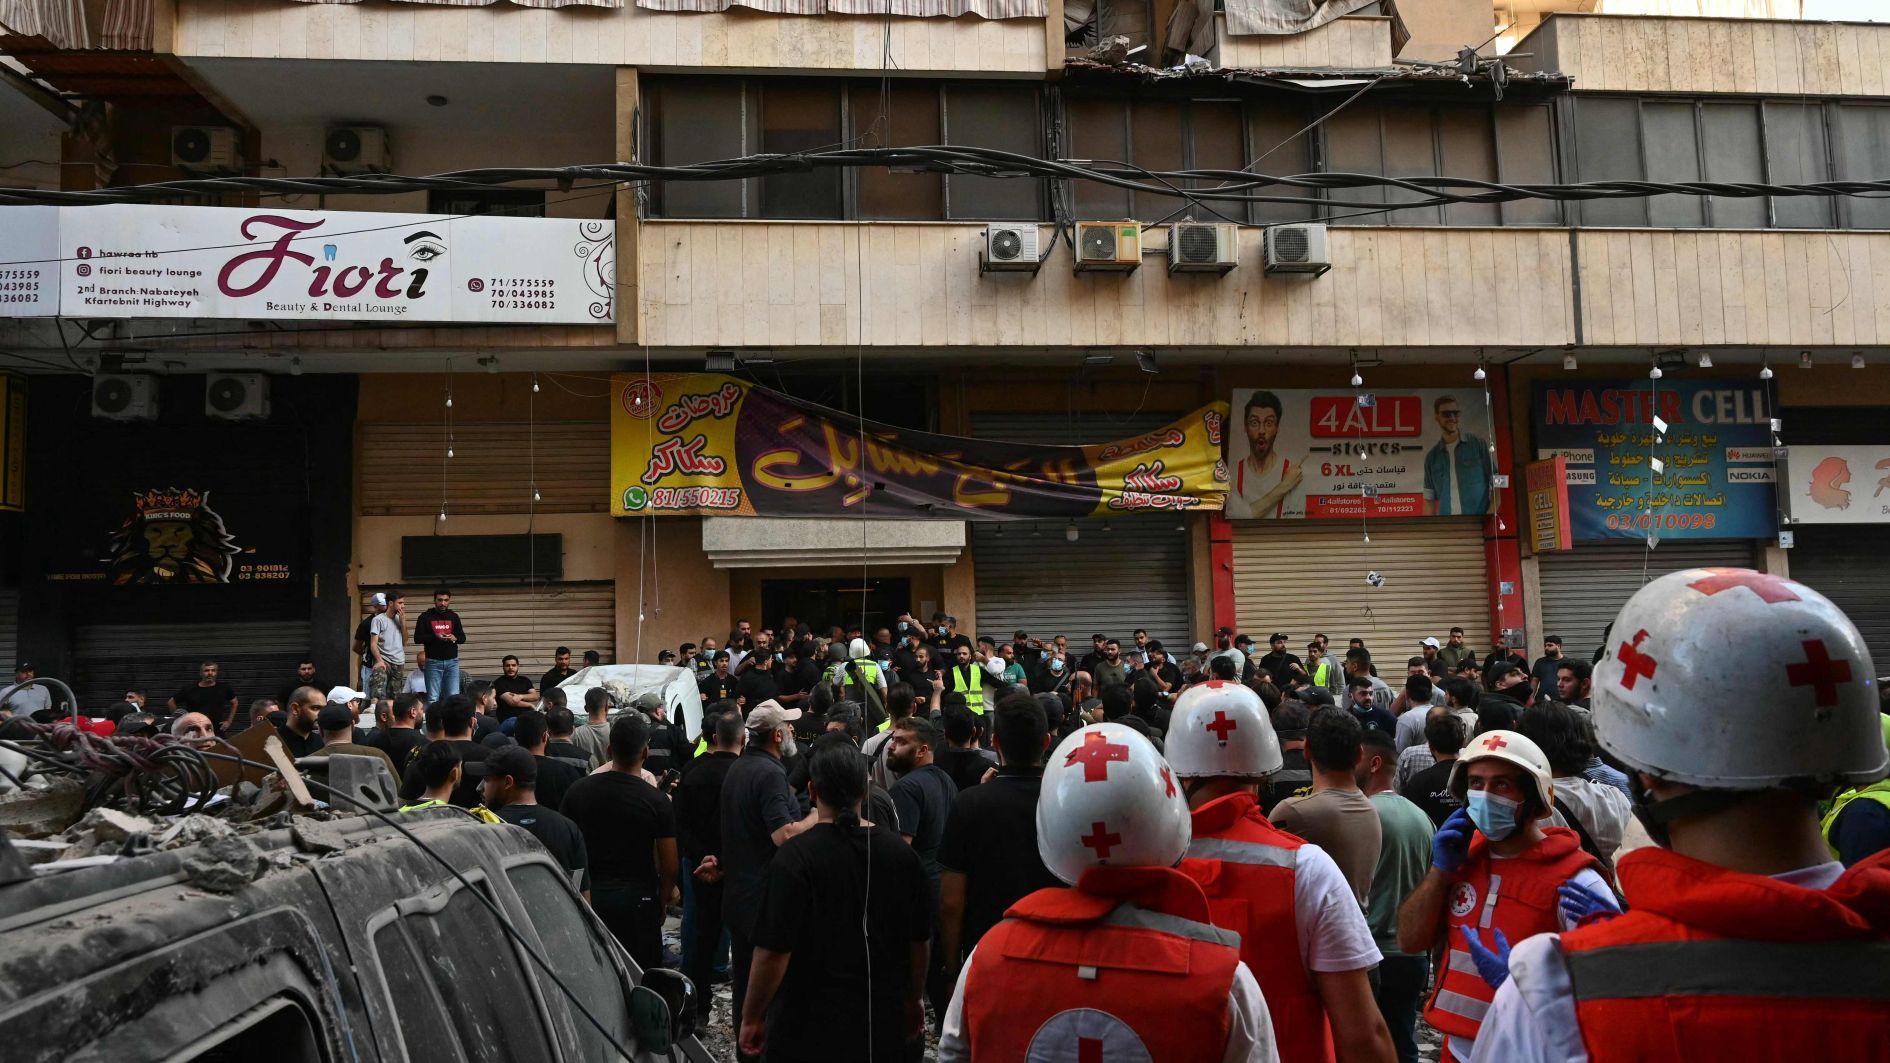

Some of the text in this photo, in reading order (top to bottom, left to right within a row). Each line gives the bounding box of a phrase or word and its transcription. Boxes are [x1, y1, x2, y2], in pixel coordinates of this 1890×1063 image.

[217, 215, 428, 299] Fiori
[99, 266, 202, 278] fiori beauty lounge
[491, 278, 554, 288] 71/575559
[0, 294, 39, 303] 36082
[491, 289, 554, 298] 70/043985
[143, 298, 191, 308] Highway
[266, 301, 408, 315] Beauty & Dental Lounge
[491, 300, 555, 309] 70/336082
[657, 382, 740, 433] عروضات
[1545, 388, 1771, 425] MASTER CELL
[1317, 400, 1415, 433] 4ALL
[1332, 441, 1401, 456] stores
[642, 436, 725, 483] سكاكر
[1561, 450, 1593, 462] Phone
[1730, 472, 1771, 480] NOKIA
[653, 488, 740, 508] 81/550215
[1607, 514, 1716, 530] 03/010098
